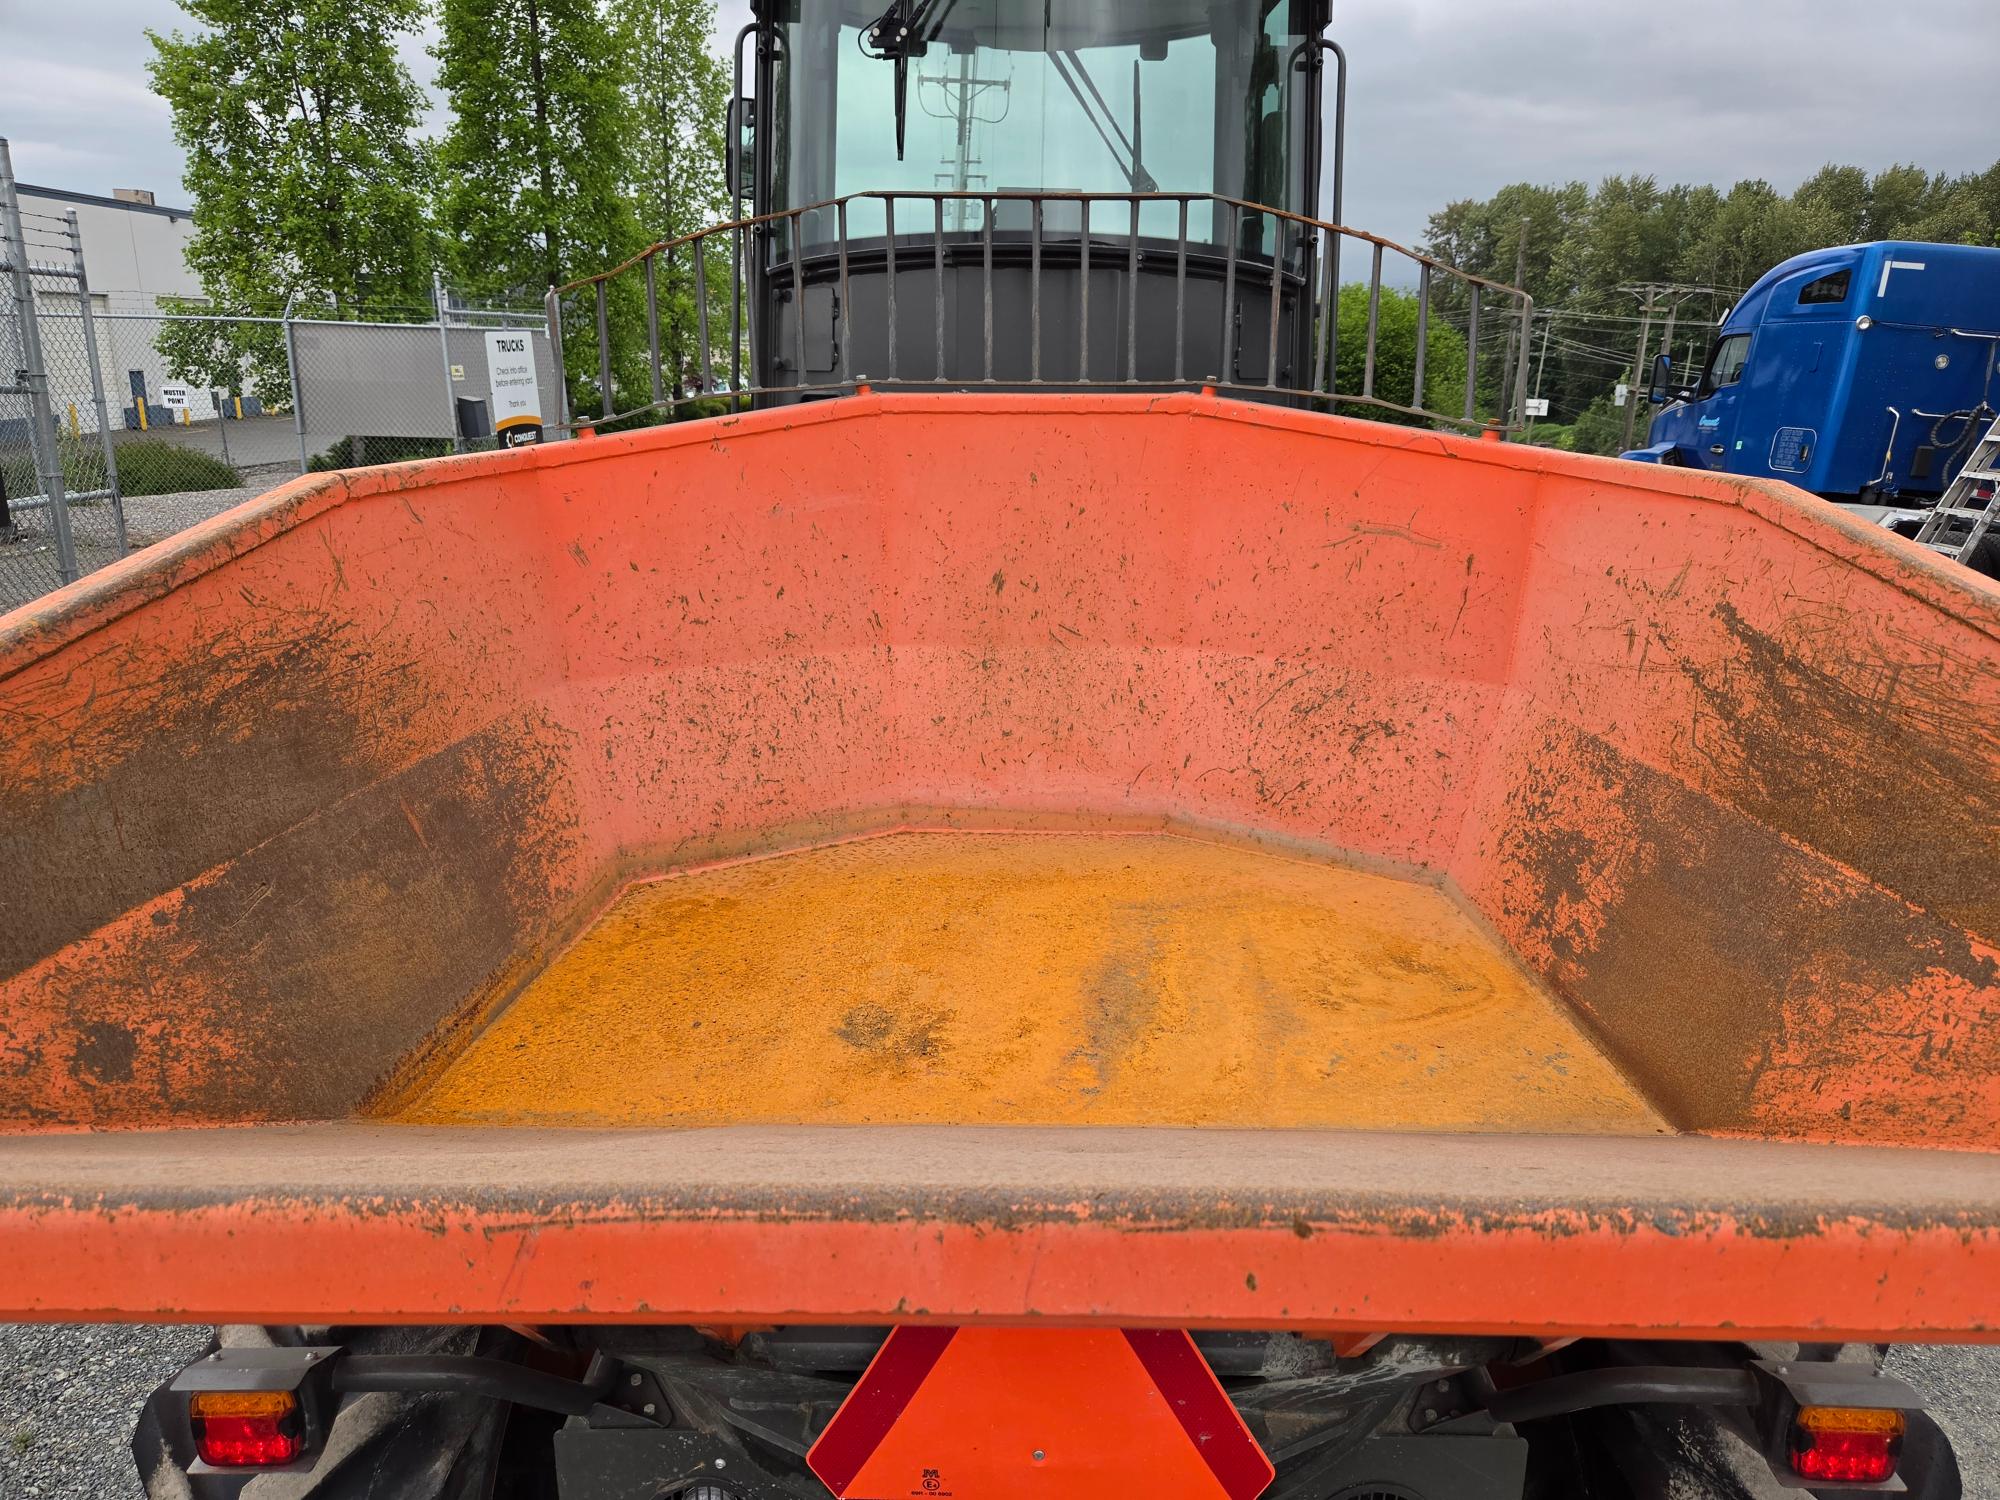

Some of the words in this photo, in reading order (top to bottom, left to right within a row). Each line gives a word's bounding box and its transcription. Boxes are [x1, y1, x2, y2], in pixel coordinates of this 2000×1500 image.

[496, 339, 525, 352] TRUCKS
[495, 379, 509, 387] before
[509, 378, 524, 386] entering
[514, 430, 536, 443] CONQUEST
